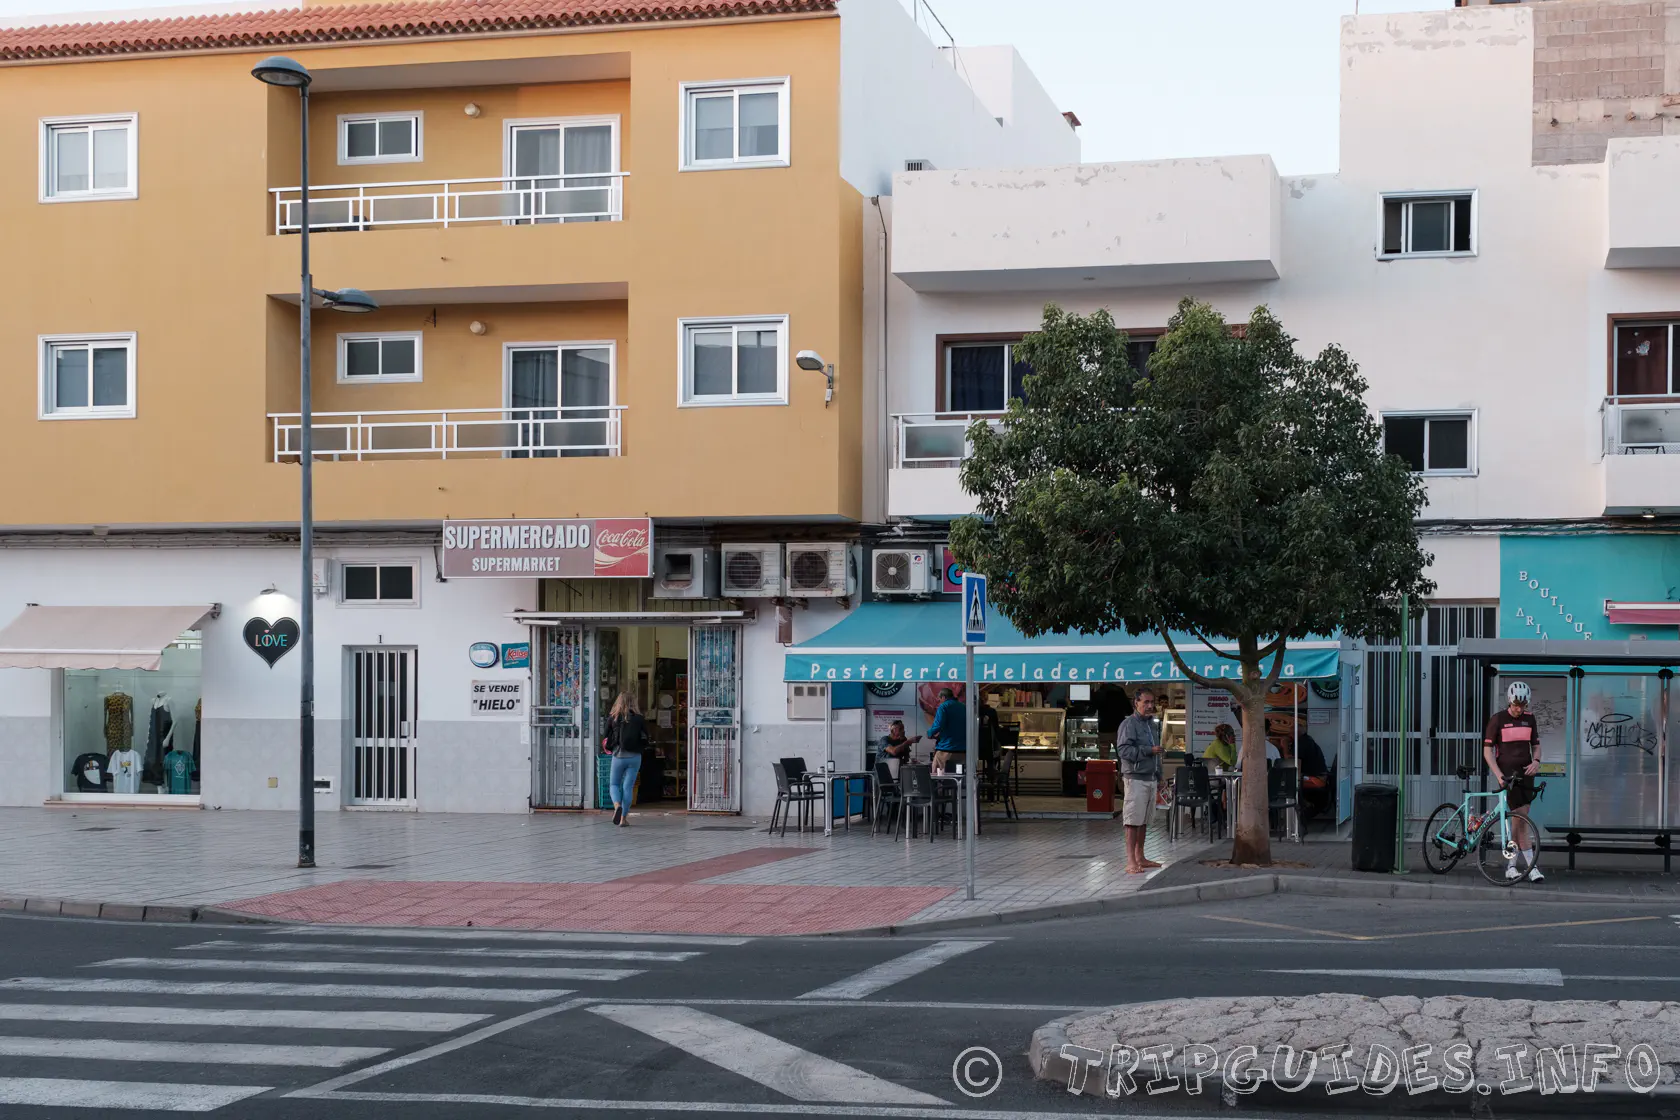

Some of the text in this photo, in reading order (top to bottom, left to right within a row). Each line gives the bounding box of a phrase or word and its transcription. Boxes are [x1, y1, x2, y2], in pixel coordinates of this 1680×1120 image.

[444, 525, 591, 549] SUPERMERCADO
[595, 528, 648, 548] Coca-Cola
[472, 557, 561, 572] SUPERMARKET
[1519, 571, 1592, 640] BOUTIQUE
[810, 662, 958, 680] Pastelería
[1421, 672, 1427, 680] 3
[473, 685, 520, 693] SE VENDE
